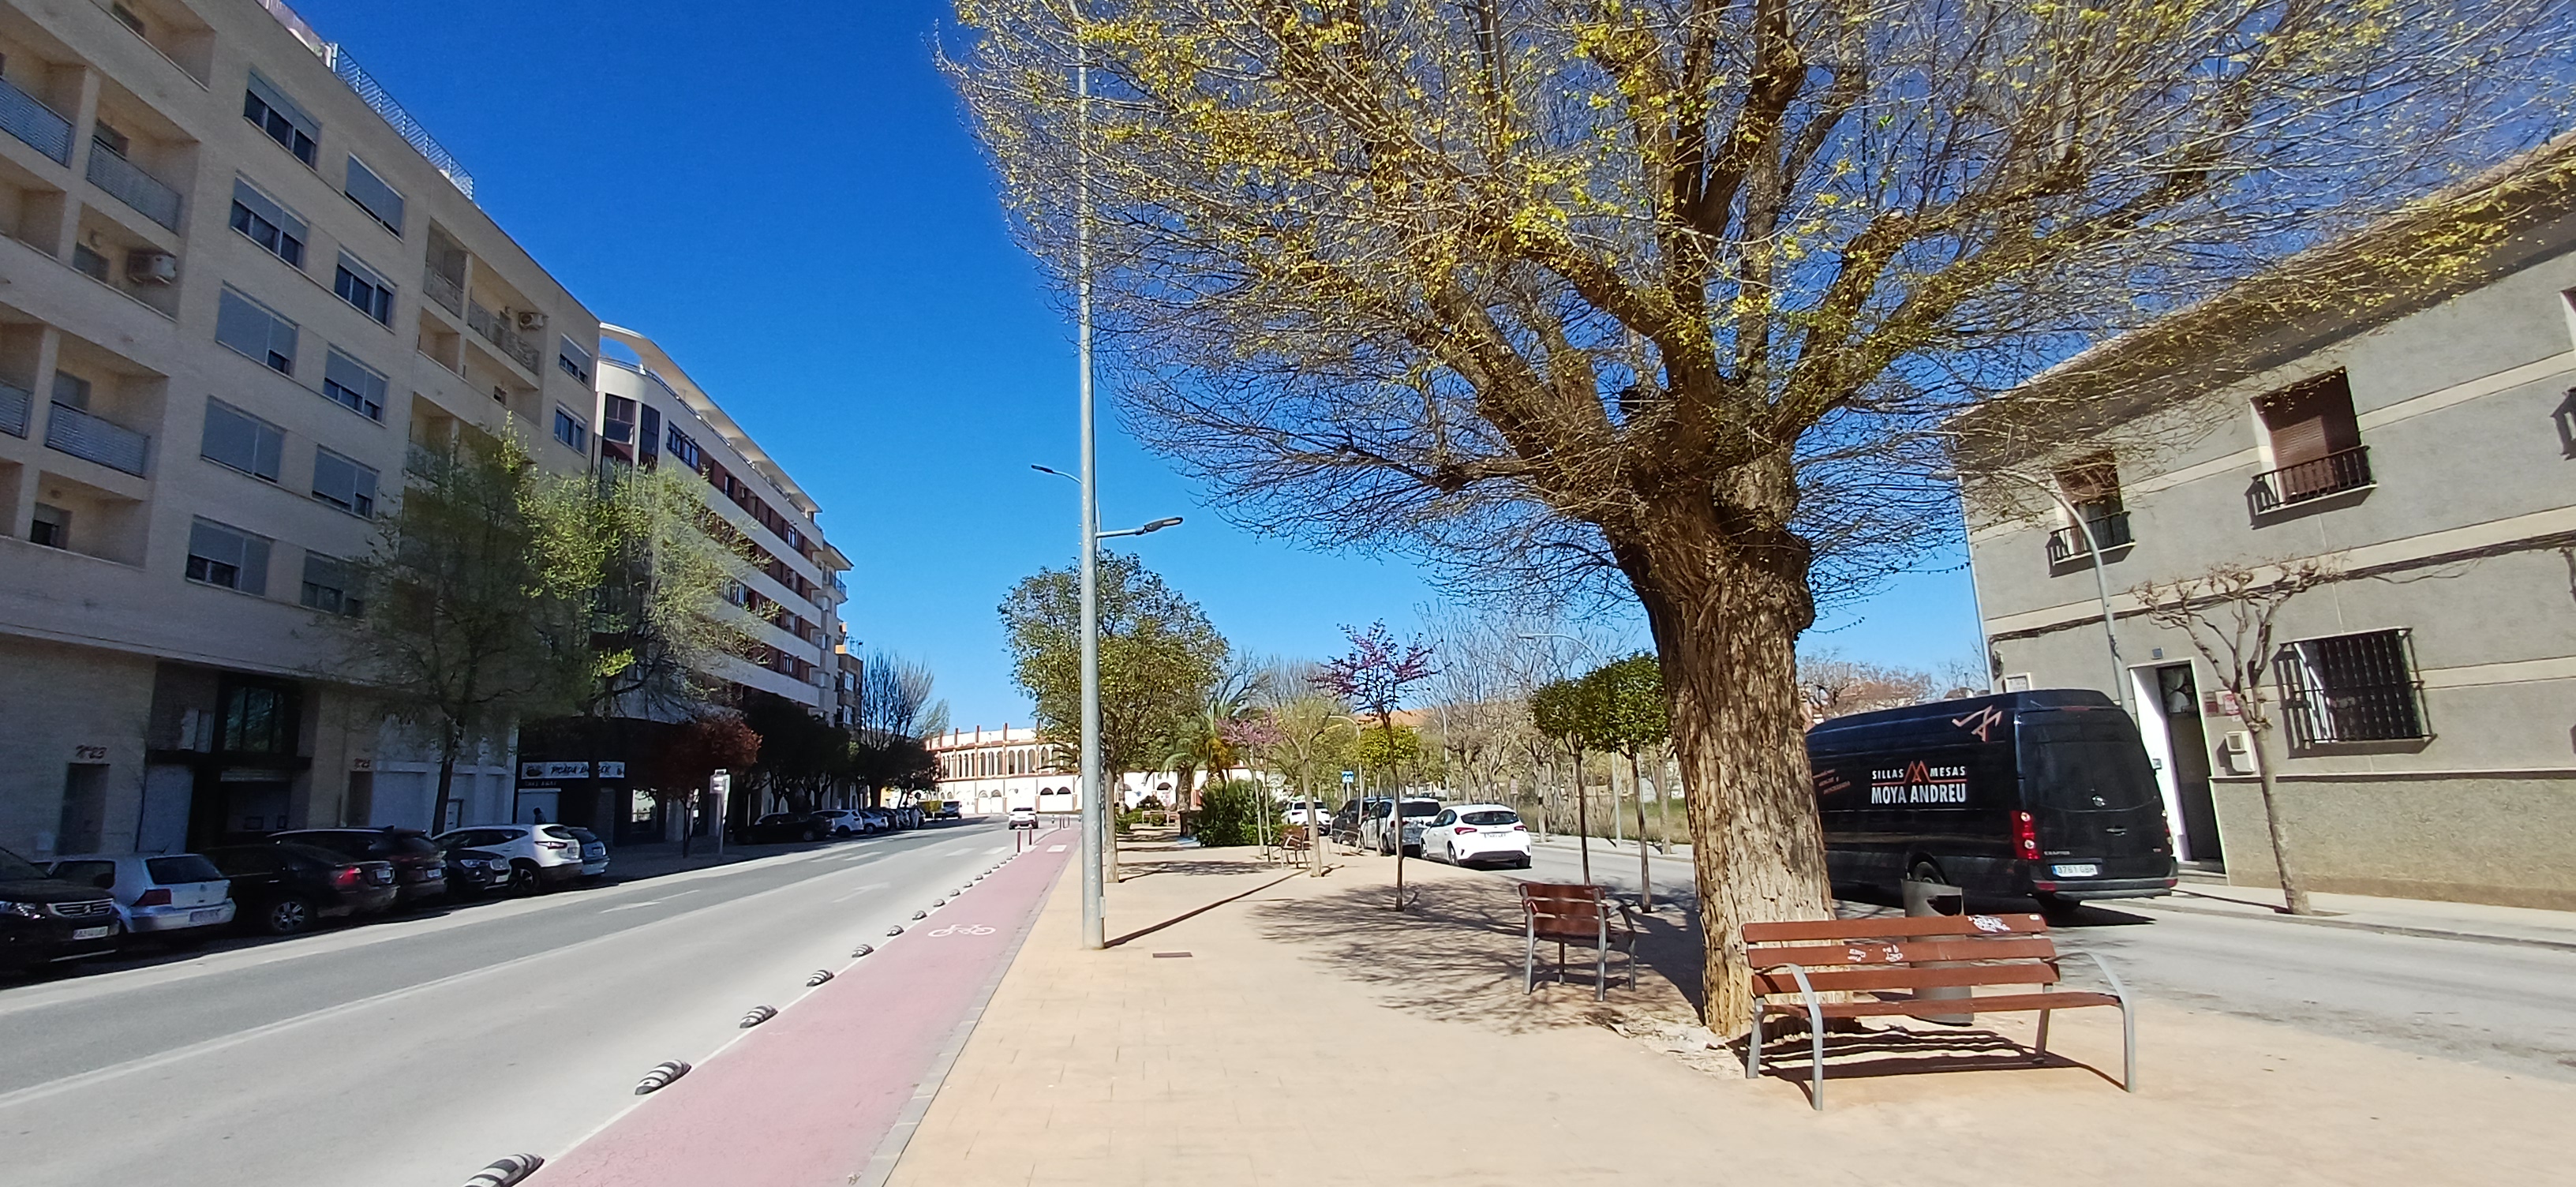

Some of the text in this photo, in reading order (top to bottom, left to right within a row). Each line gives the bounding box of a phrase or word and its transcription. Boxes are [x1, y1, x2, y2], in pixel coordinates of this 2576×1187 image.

[1872, 769, 1904, 780] SILLAS
[1930, 766, 1966, 777] MESAS
[1871, 786, 1907, 804] MOYA
[1910, 783, 1966, 803] ANDREU
